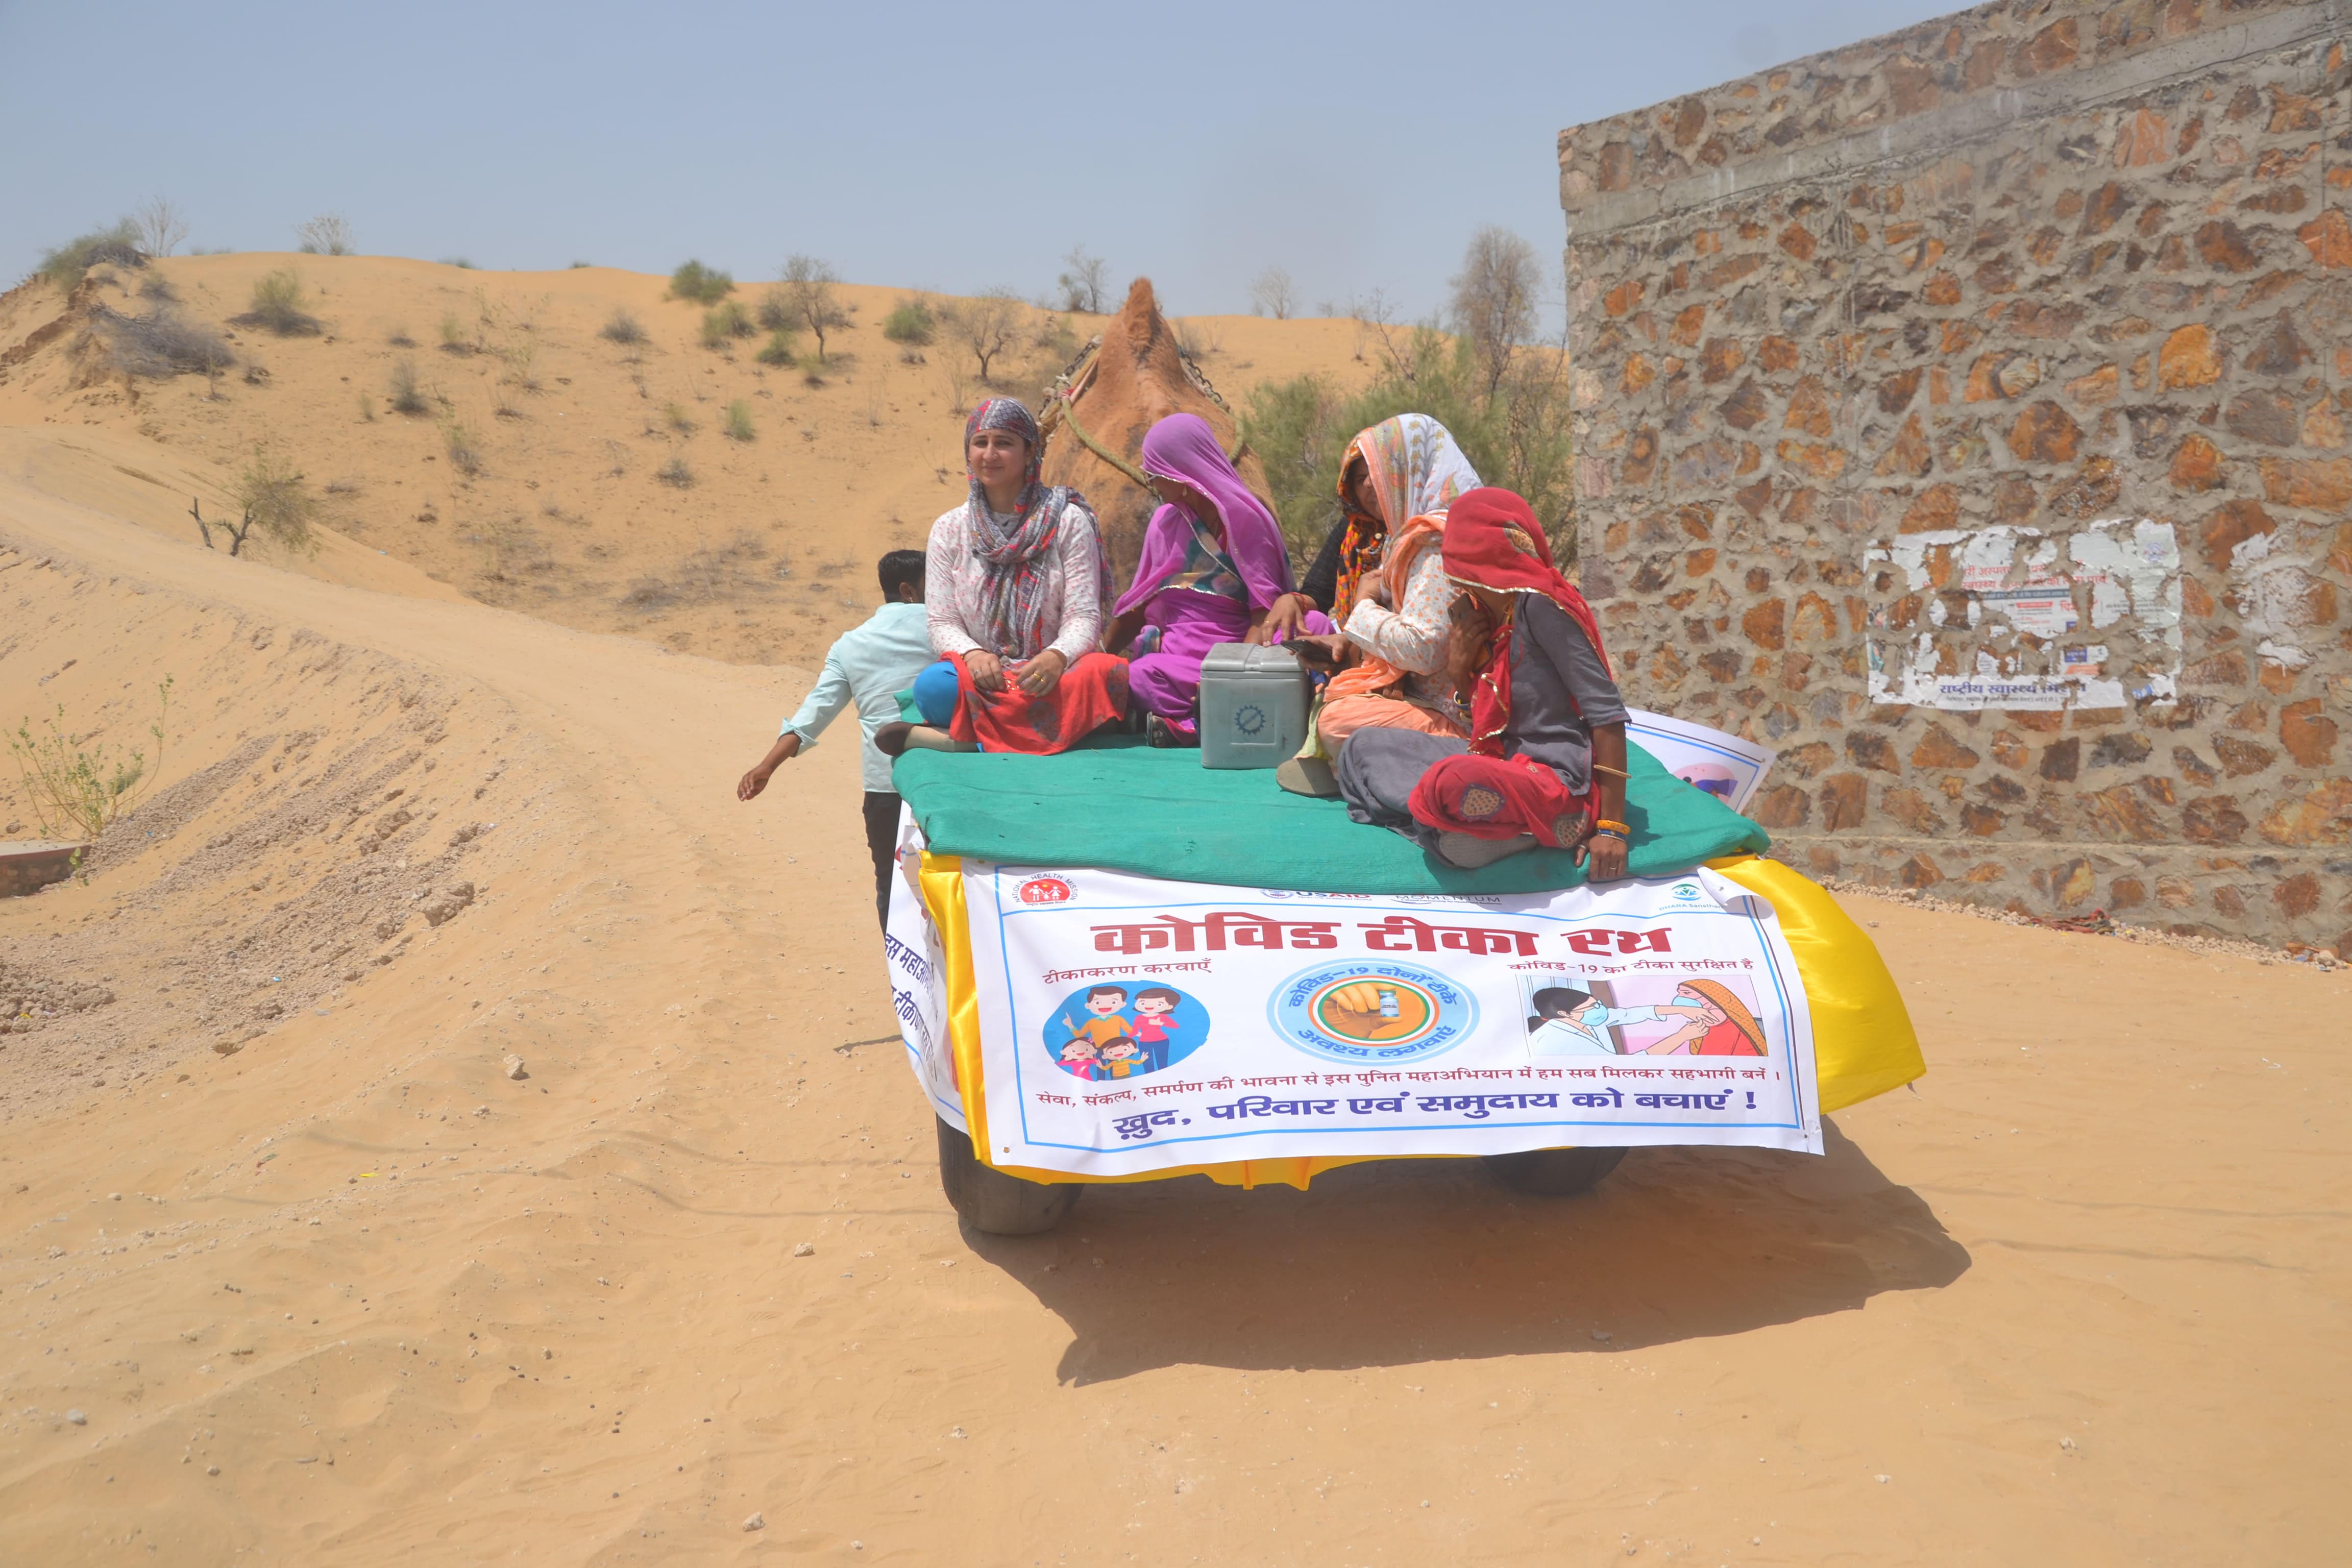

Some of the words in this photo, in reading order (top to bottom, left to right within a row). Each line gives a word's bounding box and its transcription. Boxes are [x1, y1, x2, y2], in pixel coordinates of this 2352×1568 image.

[1940, 681, 1983, 695] राष्ट्रीय
[1012, 879, 1029, 903] NATIONAL
[1065, 878, 1078, 901] MISSION
[1091, 913, 1341, 954] कोविड
[1358, 916, 1539, 956] टीका
[1561, 928, 1672, 956] रथ
[1042, 966, 1137, 984] टीकाकरण
[1142, 959, 1211, 973] करवाएँ
[1509, 961, 1597, 973] कोविड-19
[1634, 960, 1674, 969] टीका
[1678, 959, 1736, 971] सुरक्षित
[1741, 959, 1753, 969] है
[1376, 967, 1433, 983] दोनों
[1427, 979, 1457, 1005] टीके
[1298, 1029, 1371, 1057] अवश्य
[1377, 1025, 1457, 1057] लगवाएं
[1037, 1091, 1076, 1107] सेवा,
[1082, 1090, 1136, 1106] संकल्प,
[1141, 1081, 1204, 1097] समर्पण
[1208, 1076, 1234, 1090] की
[1241, 1076, 1297, 1087] भावना
[1302, 1072, 1318, 1085] से
[1322, 1074, 1351, 1086] इस
[1355, 1070, 1402, 1087] पुनित
[1405, 1068, 1513, 1081] महाअभियान
[1517, 1066, 1532, 1078] में
[1536, 1069, 1563, 1080] हम
[1567, 1069, 1597, 1078] सब
[1601, 1066, 1664, 1078] मिलकर
[1668, 1067, 1736, 1080] सहभागी
[1739, 1067, 1766, 1080] बनें
[1207, 1096, 1339, 1119] परिवार
[1348, 1092, 1410, 1114] एवं
[1416, 1094, 1559, 1118] समुदाय
[1570, 1087, 1623, 1108] को
[1634, 1089, 1733, 1109] बचाएं
